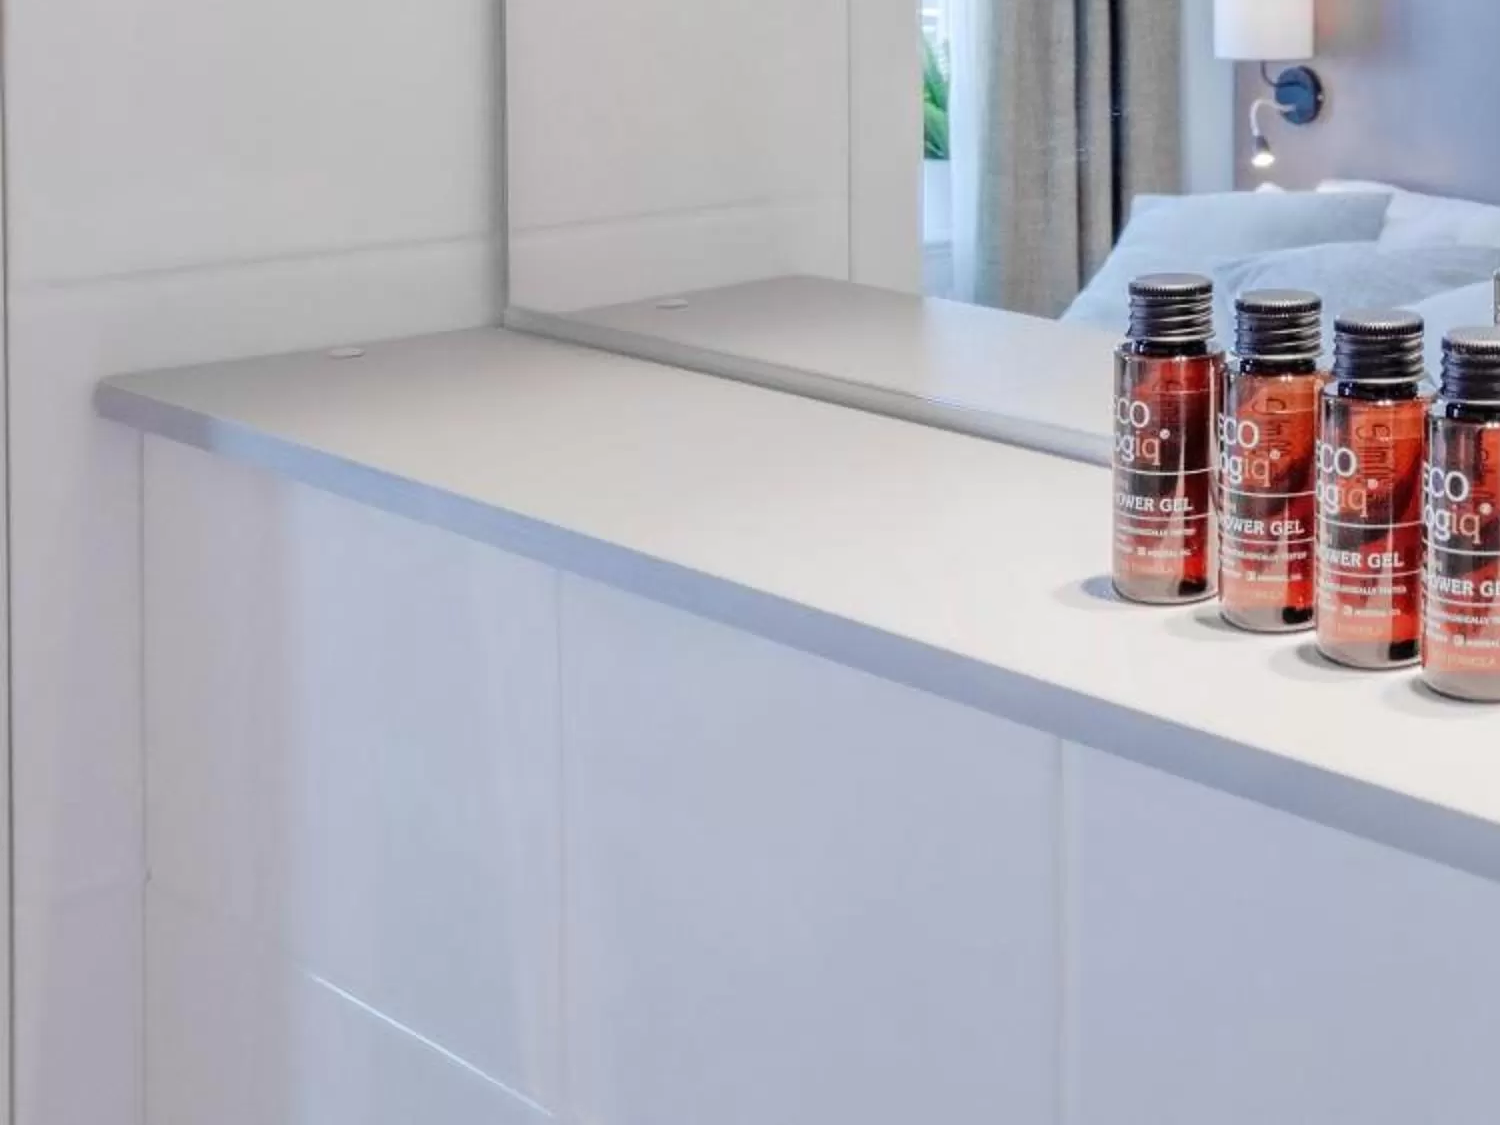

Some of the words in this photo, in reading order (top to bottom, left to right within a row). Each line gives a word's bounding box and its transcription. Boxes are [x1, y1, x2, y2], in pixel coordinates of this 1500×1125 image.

[1114, 430, 1160, 466] ogiq
[1220, 450, 1270, 487] ogiq
[1117, 494, 1155, 512] OWER
[1159, 497, 1194, 512] GEL
[1316, 480, 1368, 518] ogiq
[1223, 517, 1265, 536] OWER
[1270, 519, 1305, 536] GEL
[1423, 504, 1481, 544] ogiq
[1367, 552, 1405, 568] GEL
[1427, 576, 1474, 597] OWER
